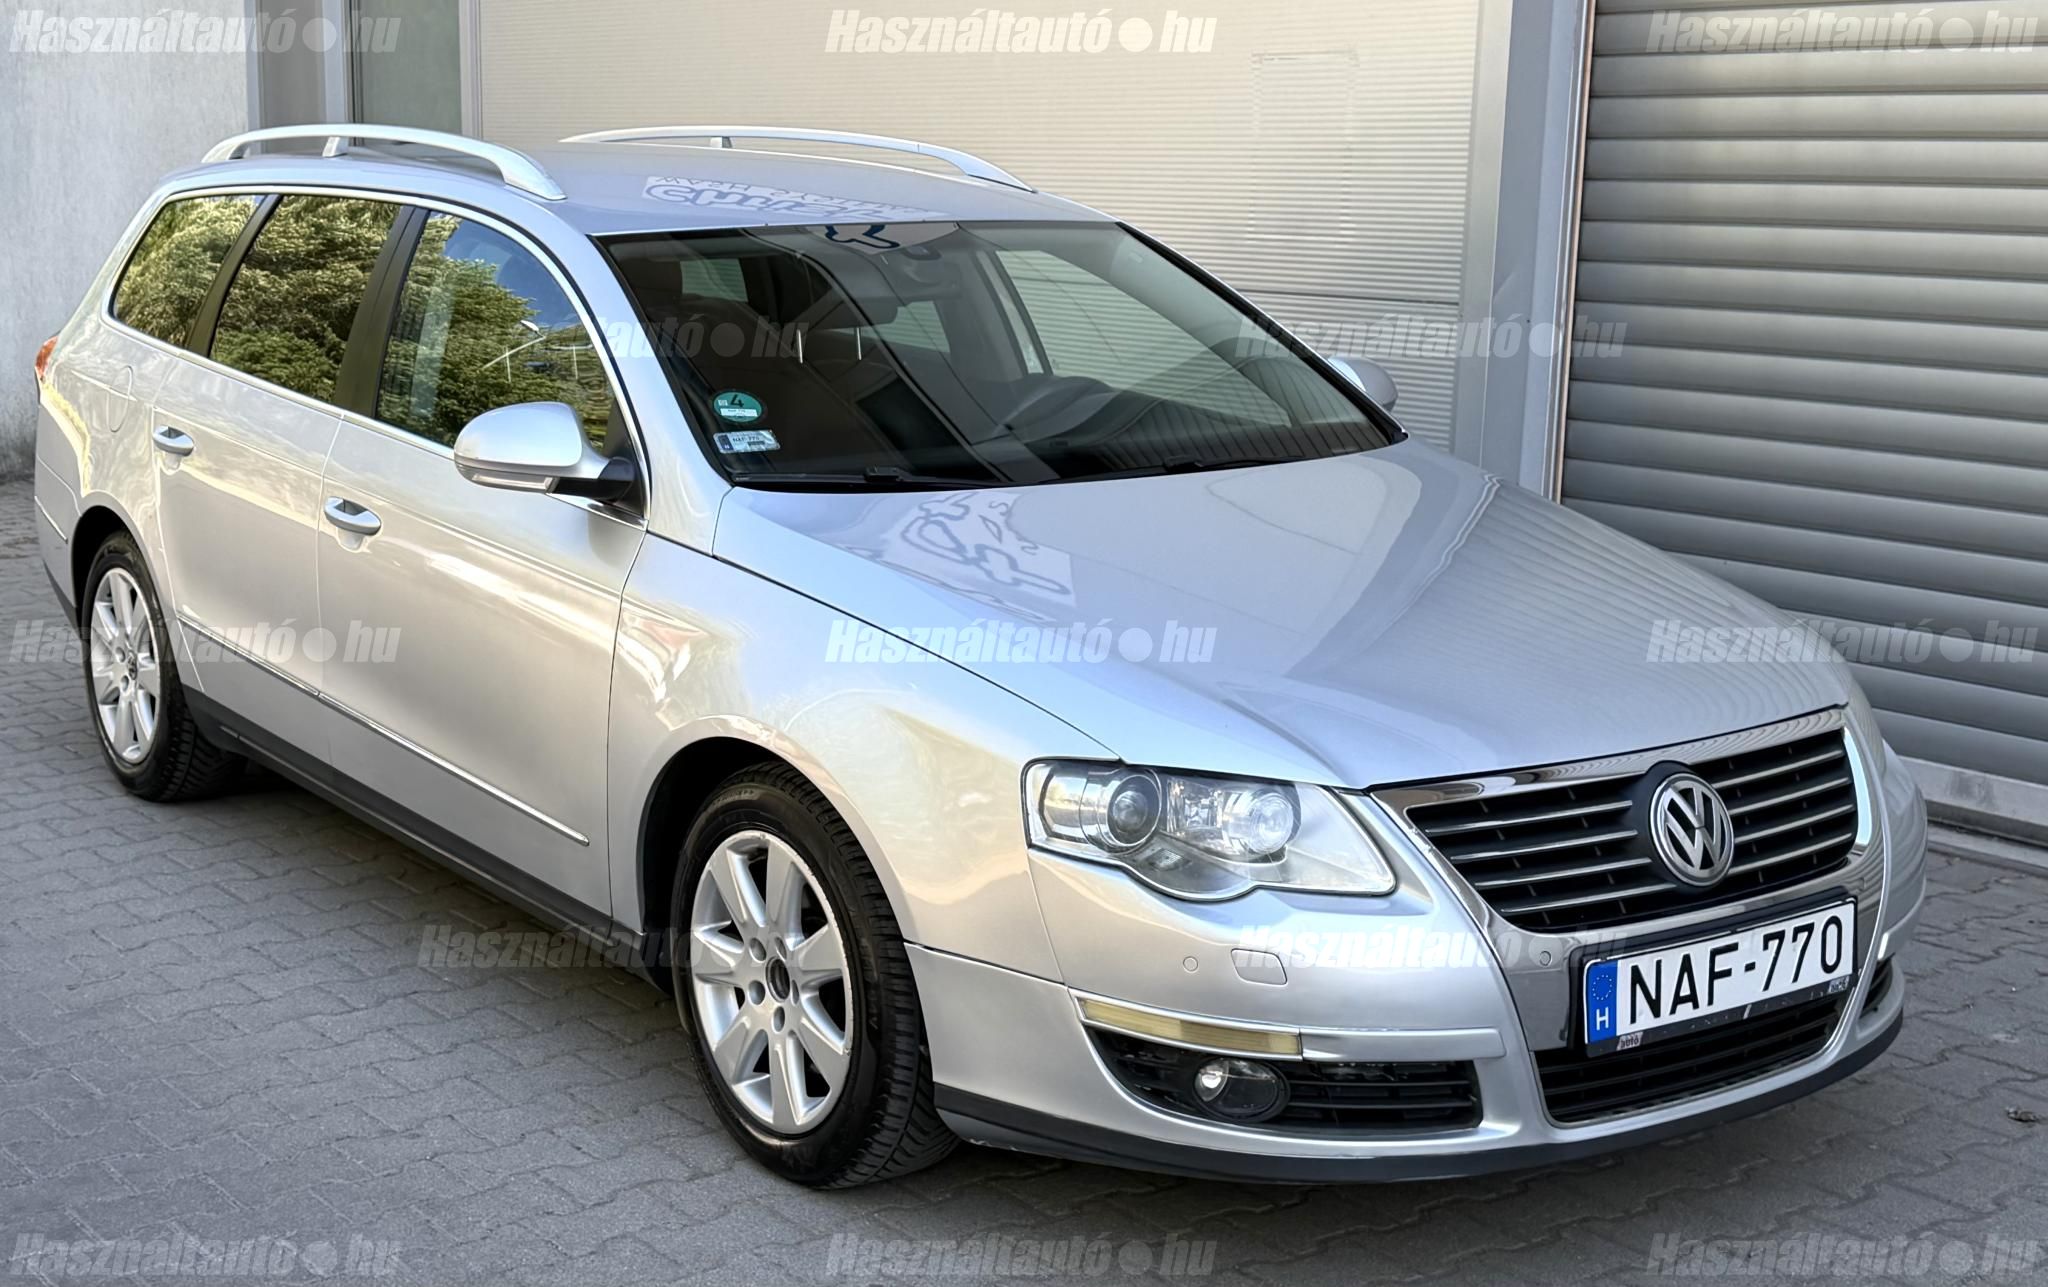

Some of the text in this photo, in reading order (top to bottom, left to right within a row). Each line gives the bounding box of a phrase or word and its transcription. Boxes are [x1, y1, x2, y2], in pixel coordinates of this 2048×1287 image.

[731, 394, 744, 408] 4
[1630, 915, 1843, 1025] NAF-770
[1596, 1007, 1609, 1031] H
